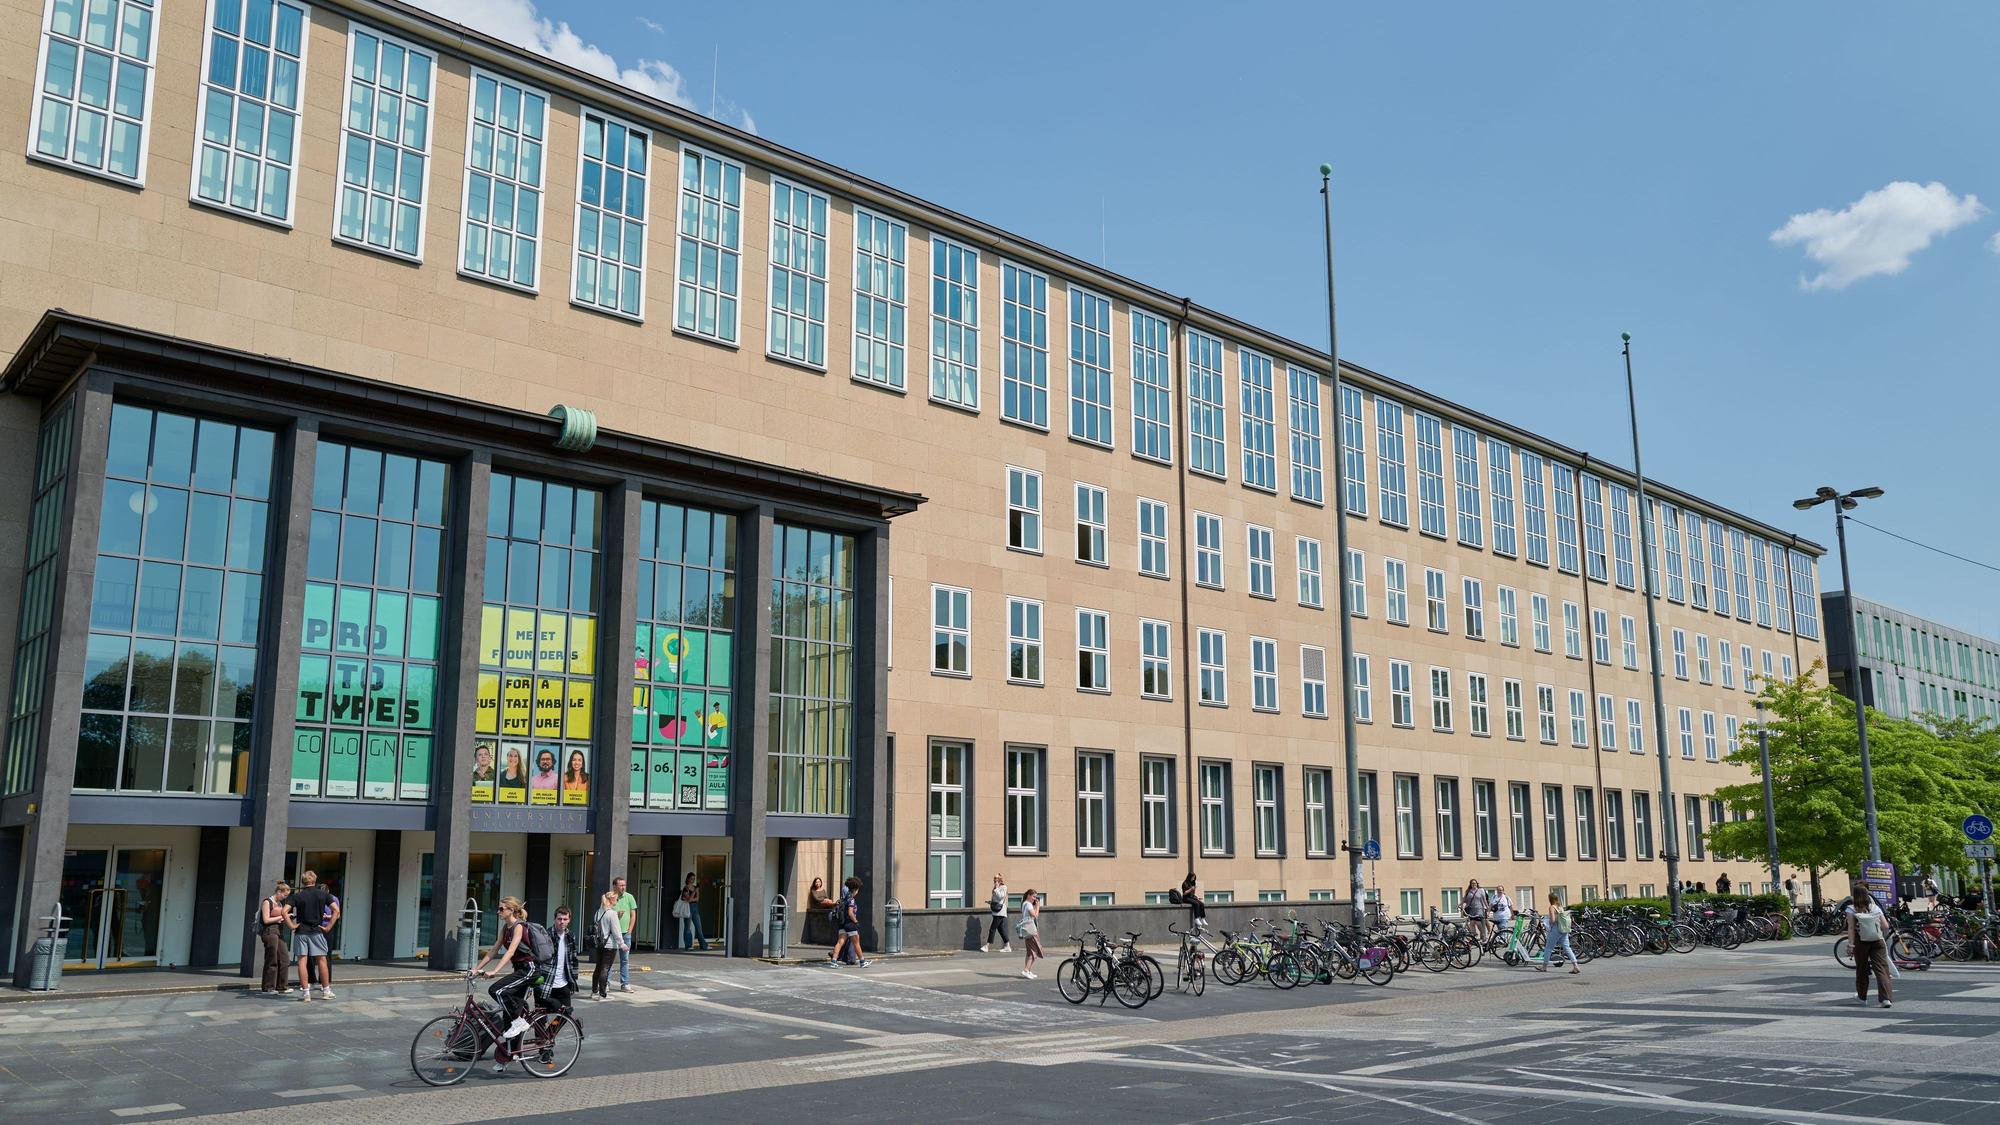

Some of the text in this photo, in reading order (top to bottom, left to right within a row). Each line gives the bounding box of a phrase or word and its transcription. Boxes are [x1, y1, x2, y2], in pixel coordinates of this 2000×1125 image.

[307, 618, 387, 650] PRO
[516, 630, 555, 641] MEET
[492, 649, 578, 660] FOUNDERS
[337, 664, 384, 691] TO
[506, 679, 549, 689] FOR A
[301, 691, 419, 724] TYPES
[504, 718, 560, 728] FUTURE
[298, 735, 417, 758] COLOGNE
[654, 762, 673, 773] 06.
[684, 766, 697, 777] 23
[472, 811, 583, 822] UNIVERSITÄT
